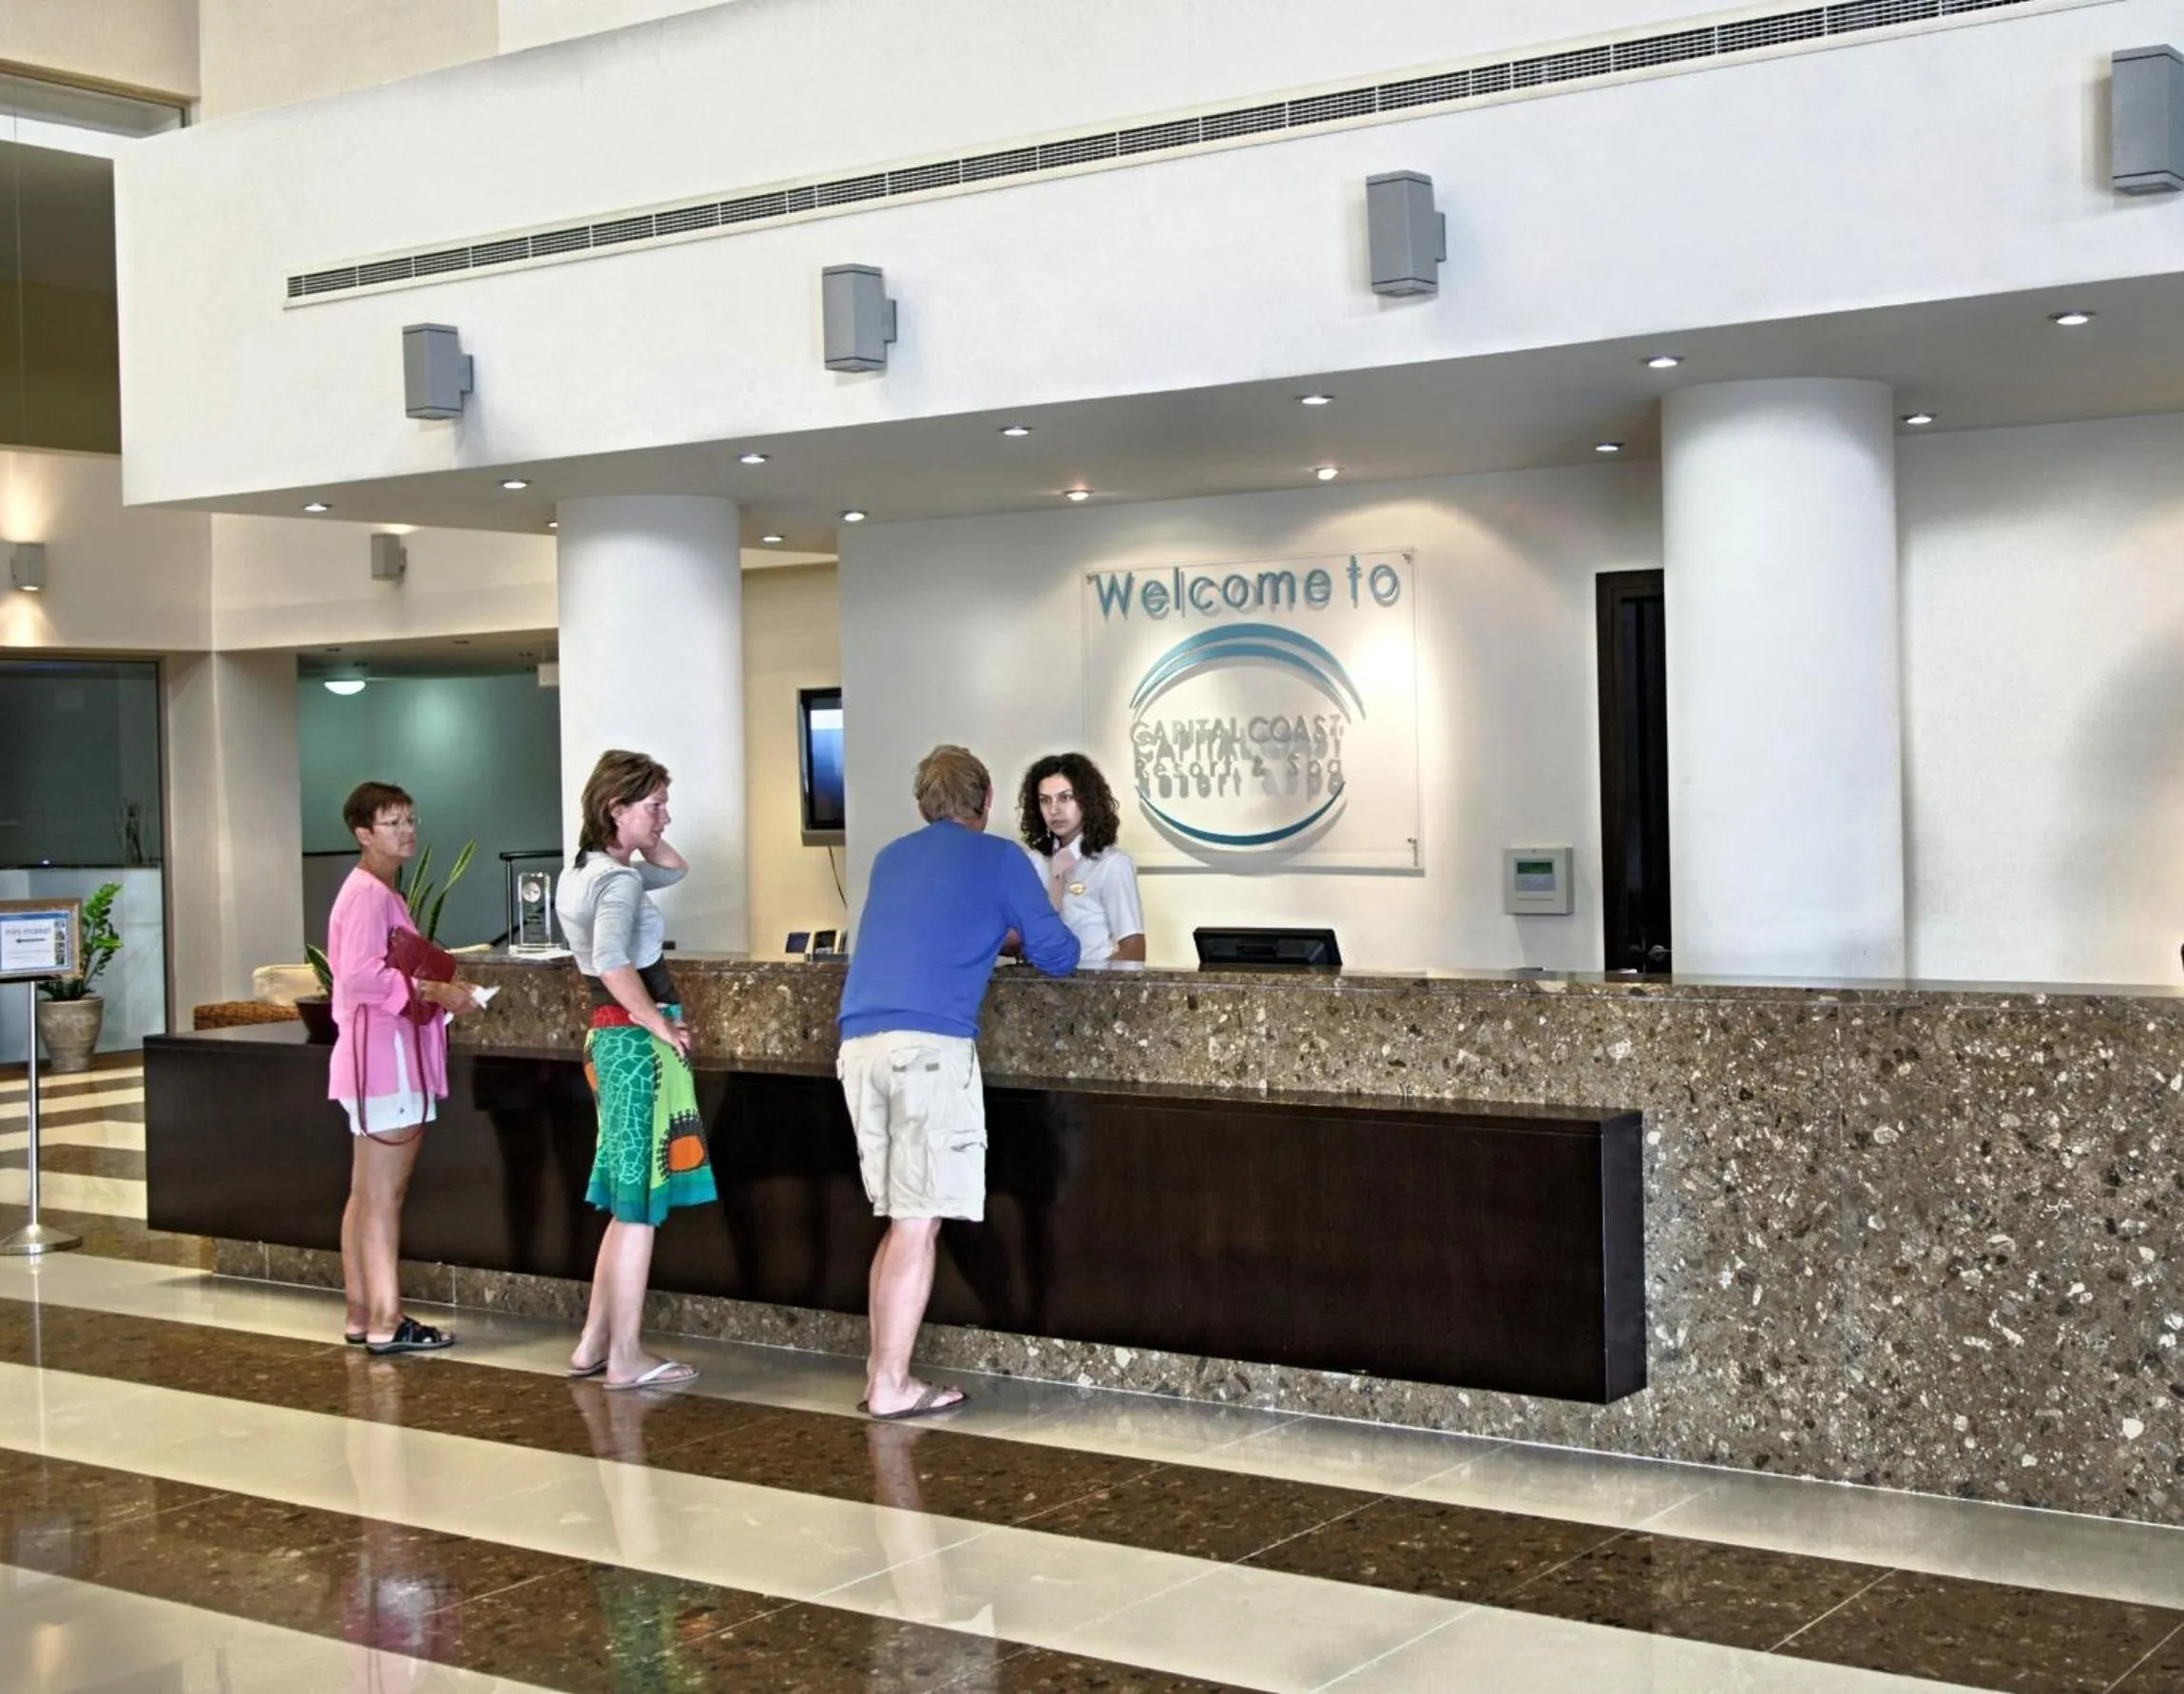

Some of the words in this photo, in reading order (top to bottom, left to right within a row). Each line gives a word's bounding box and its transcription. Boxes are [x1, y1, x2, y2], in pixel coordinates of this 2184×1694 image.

[1095, 566, 1331, 620] Welcome
[1345, 554, 1400, 607] to
[1129, 717, 1241, 746] CAPITAL
[1248, 715, 1342, 744] COAST
[1135, 755, 1233, 779] Resort
[1288, 752, 1342, 783] Spa
